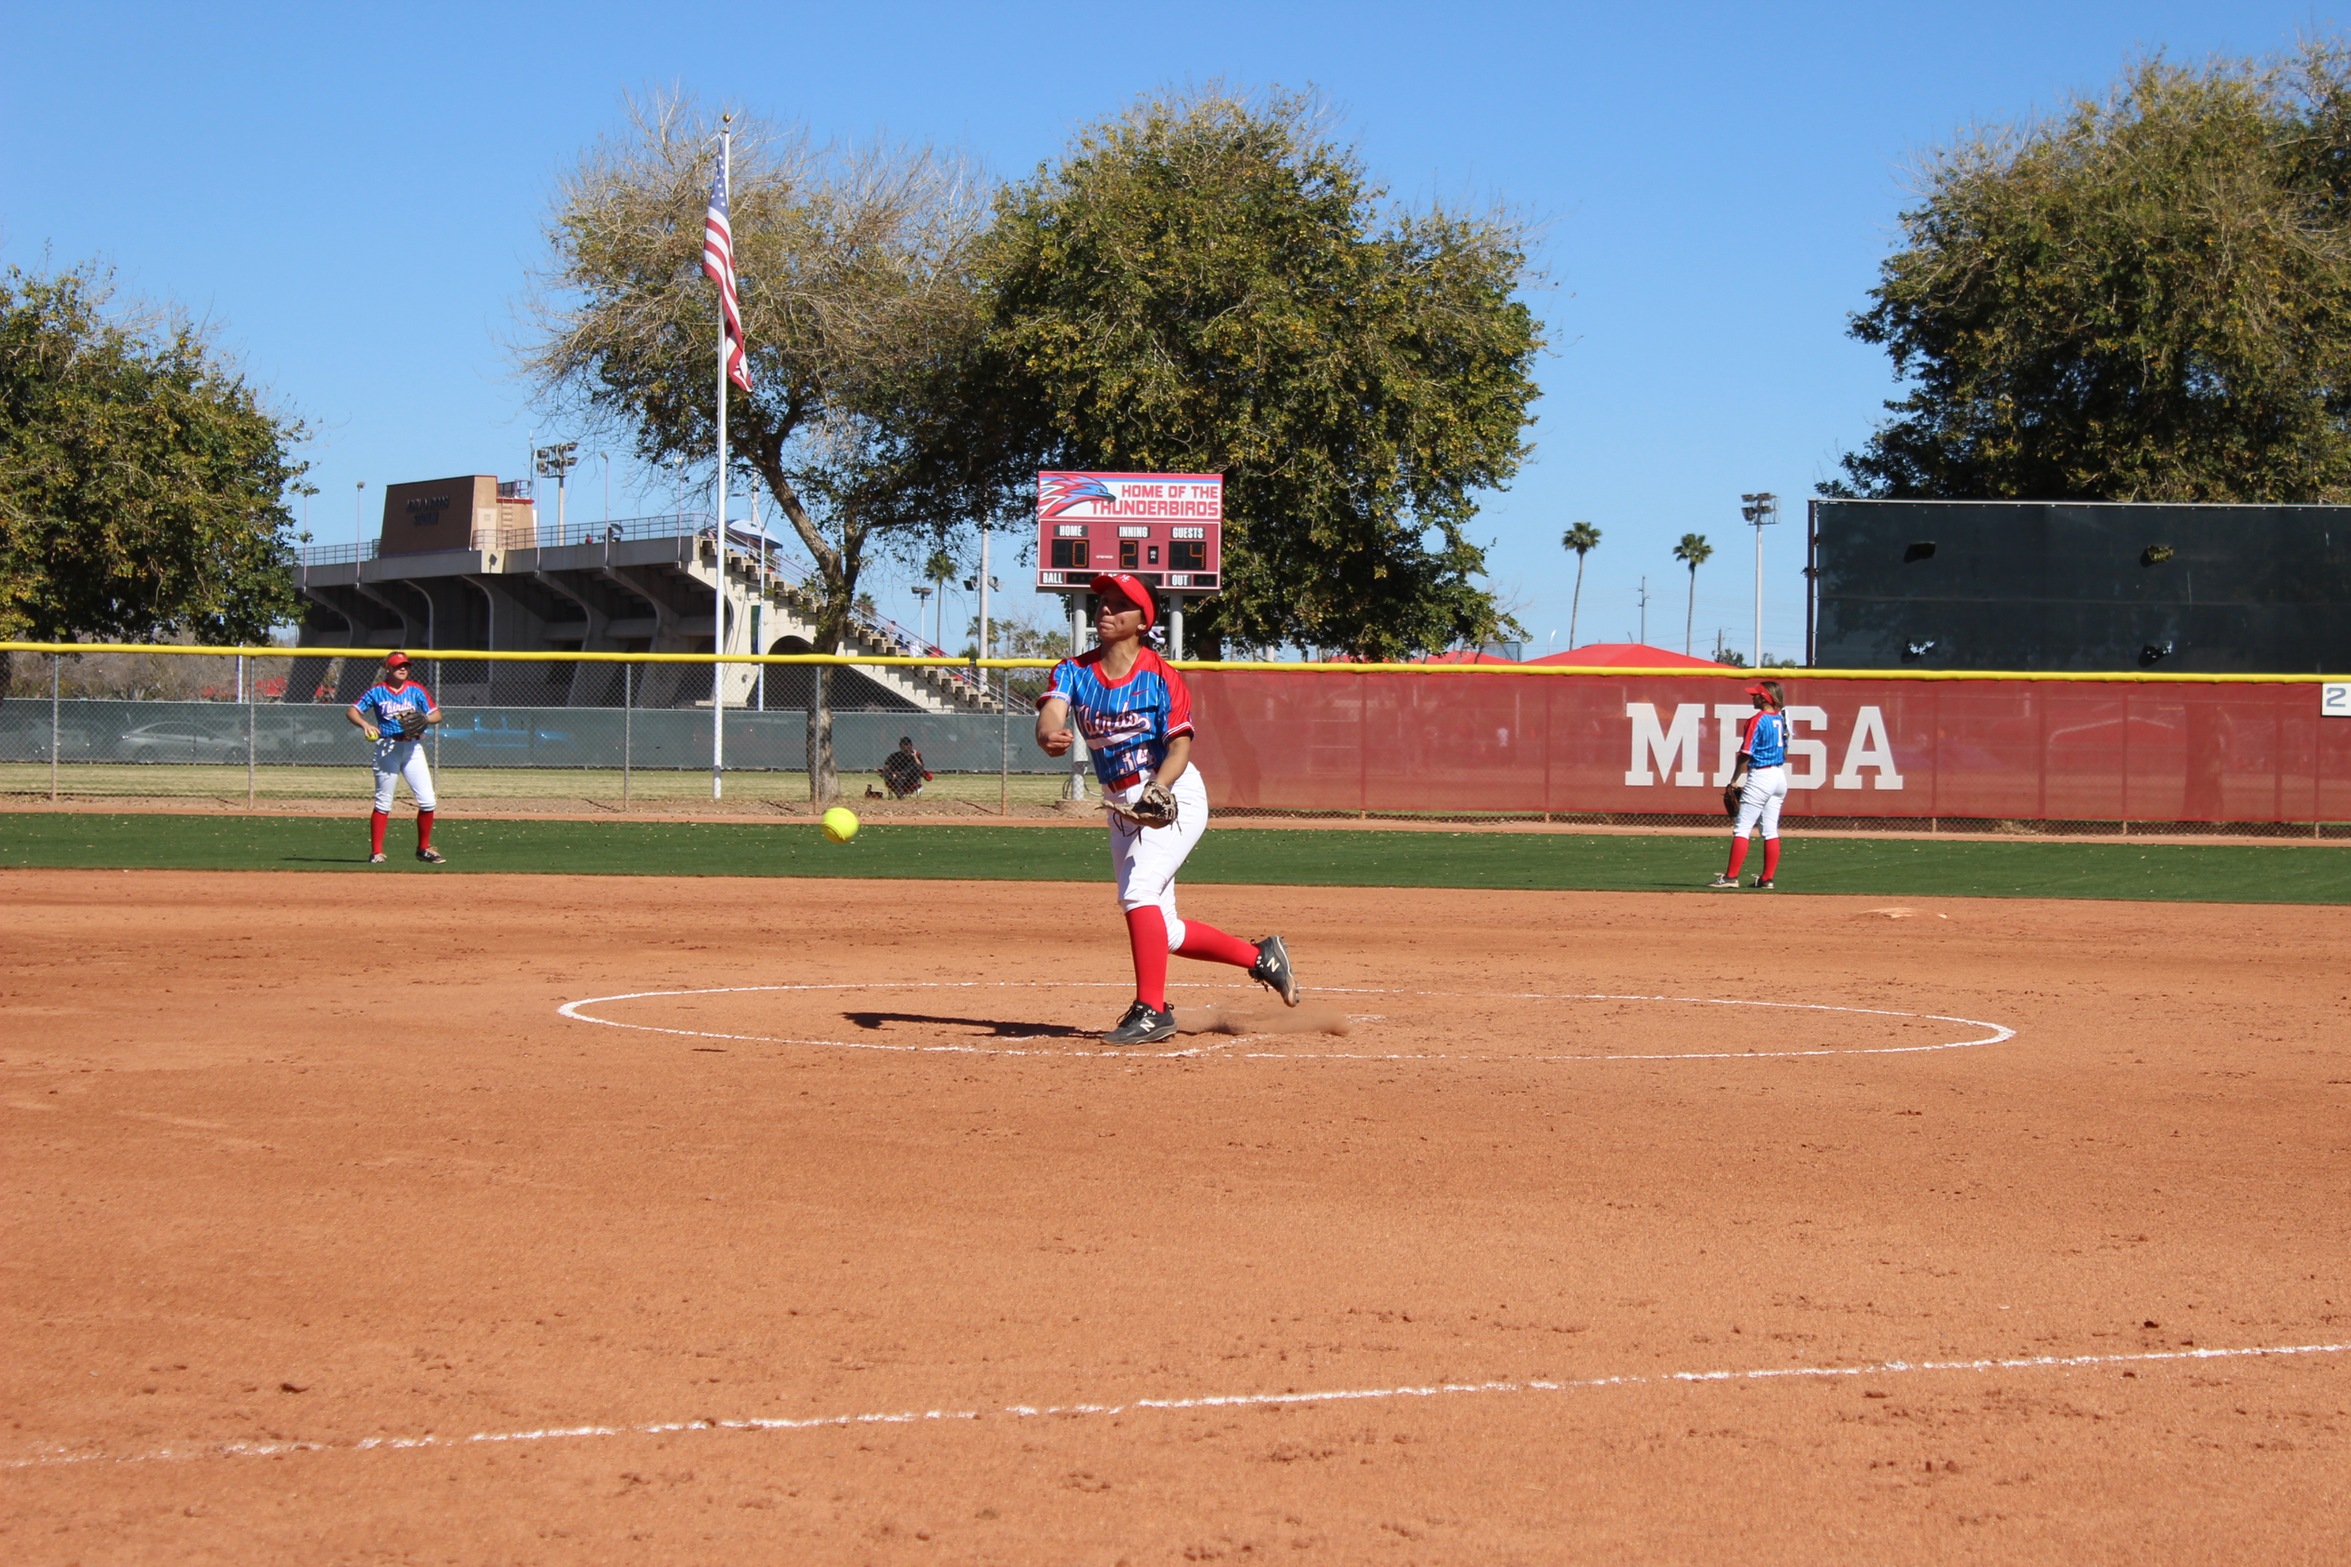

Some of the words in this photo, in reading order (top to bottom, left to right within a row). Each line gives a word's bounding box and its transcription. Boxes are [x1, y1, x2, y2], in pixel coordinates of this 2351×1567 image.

[1122, 485, 1163, 498] HOME
[1168, 485, 1186, 499] OF
[1191, 485, 1219, 499] THE
[1090, 500, 1219, 517] THUNDERBIRDS
[1059, 525, 1082, 536] HOME
[1118, 526, 1148, 538] INNING
[1172, 527, 1204, 539] GUESTS
[1121, 541, 1137, 569] 2
[1189, 543, 1205, 569] 4
[1042, 572, 1063, 584] BALL
[1172, 574, 1188, 586] OUT
[2326, 687, 2347, 708] 2
[1119, 743, 1153, 774] 34
